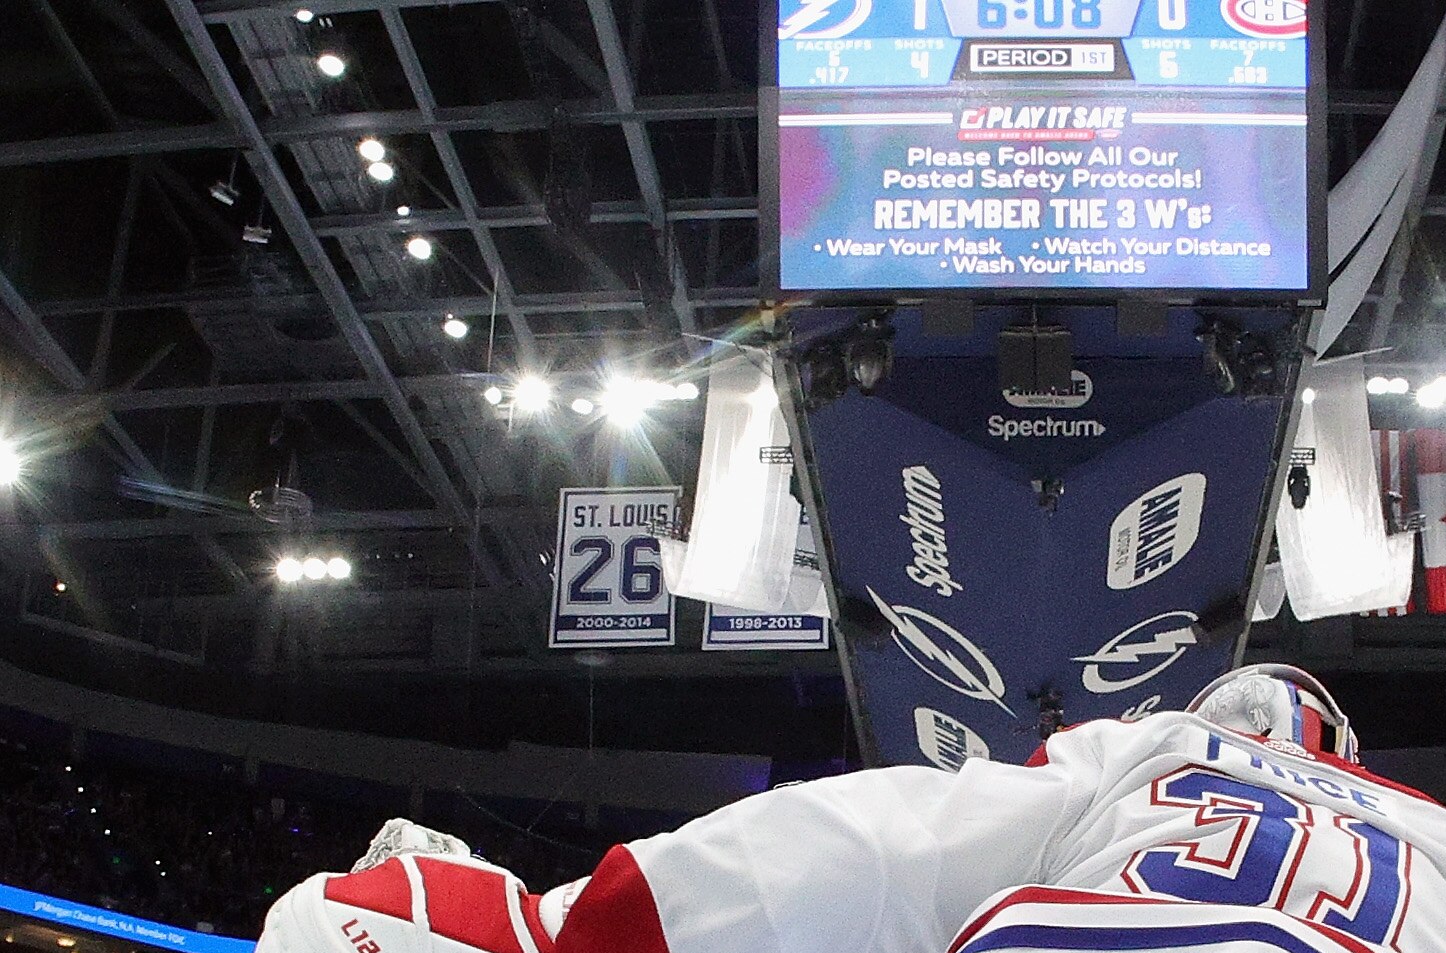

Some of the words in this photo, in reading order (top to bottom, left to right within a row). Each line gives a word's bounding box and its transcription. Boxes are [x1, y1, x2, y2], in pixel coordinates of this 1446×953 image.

[796, 40, 872, 51] FACEOFFS
[894, 39, 944, 50] SHOTS
[1141, 39, 1191, 50] SHOTS
[1210, 39, 1286, 51] FACEOFFS
[910, 51, 930, 79] 4
[983, 49, 1068, 66] PERIOD
[1243, 50, 1255, 66] 7
[809, 67, 849, 85] .417
[986, 106, 1045, 129] PLAY
[1047, 106, 1072, 129] IT
[1073, 106, 1128, 129] SAFE
[908, 147, 991, 167] Please
[998, 146, 1083, 166] Follow
[1088, 146, 1122, 166] All
[1128, 146, 1179, 166] Our
[883, 169, 974, 189] Posted
[981, 168, 1066, 193] Safety
[1072, 168, 1202, 189] Protocols!
[874, 198, 1041, 230] REMEMBER
[1050, 198, 1108, 229] THE
[1116, 199, 1136, 229] 3
[826, 238, 886, 256] Wear
[889, 237, 940, 256] Your
[944, 237, 1003, 255] Mask
[1044, 237, 1117, 255] Watch
[1121, 237, 1172, 256] Your
[1176, 237, 1271, 256] Distance
[952, 256, 1015, 274] Wash
[1018, 256, 1071, 274] Your
[1075, 256, 1146, 274] Hands
[988, 414, 1100, 442] Spectrum
[574, 505, 602, 528] ST.
[610, 504, 669, 528] LOUIS
[899, 467, 963, 597] Spectrum
[1133, 485, 1182, 581] AMALIE
[567, 534, 664, 605] 26
[576, 616, 652, 629] 2000-2014
[729, 617, 802, 630] 1998-2013
[1120, 763, 1413, 953] 31
